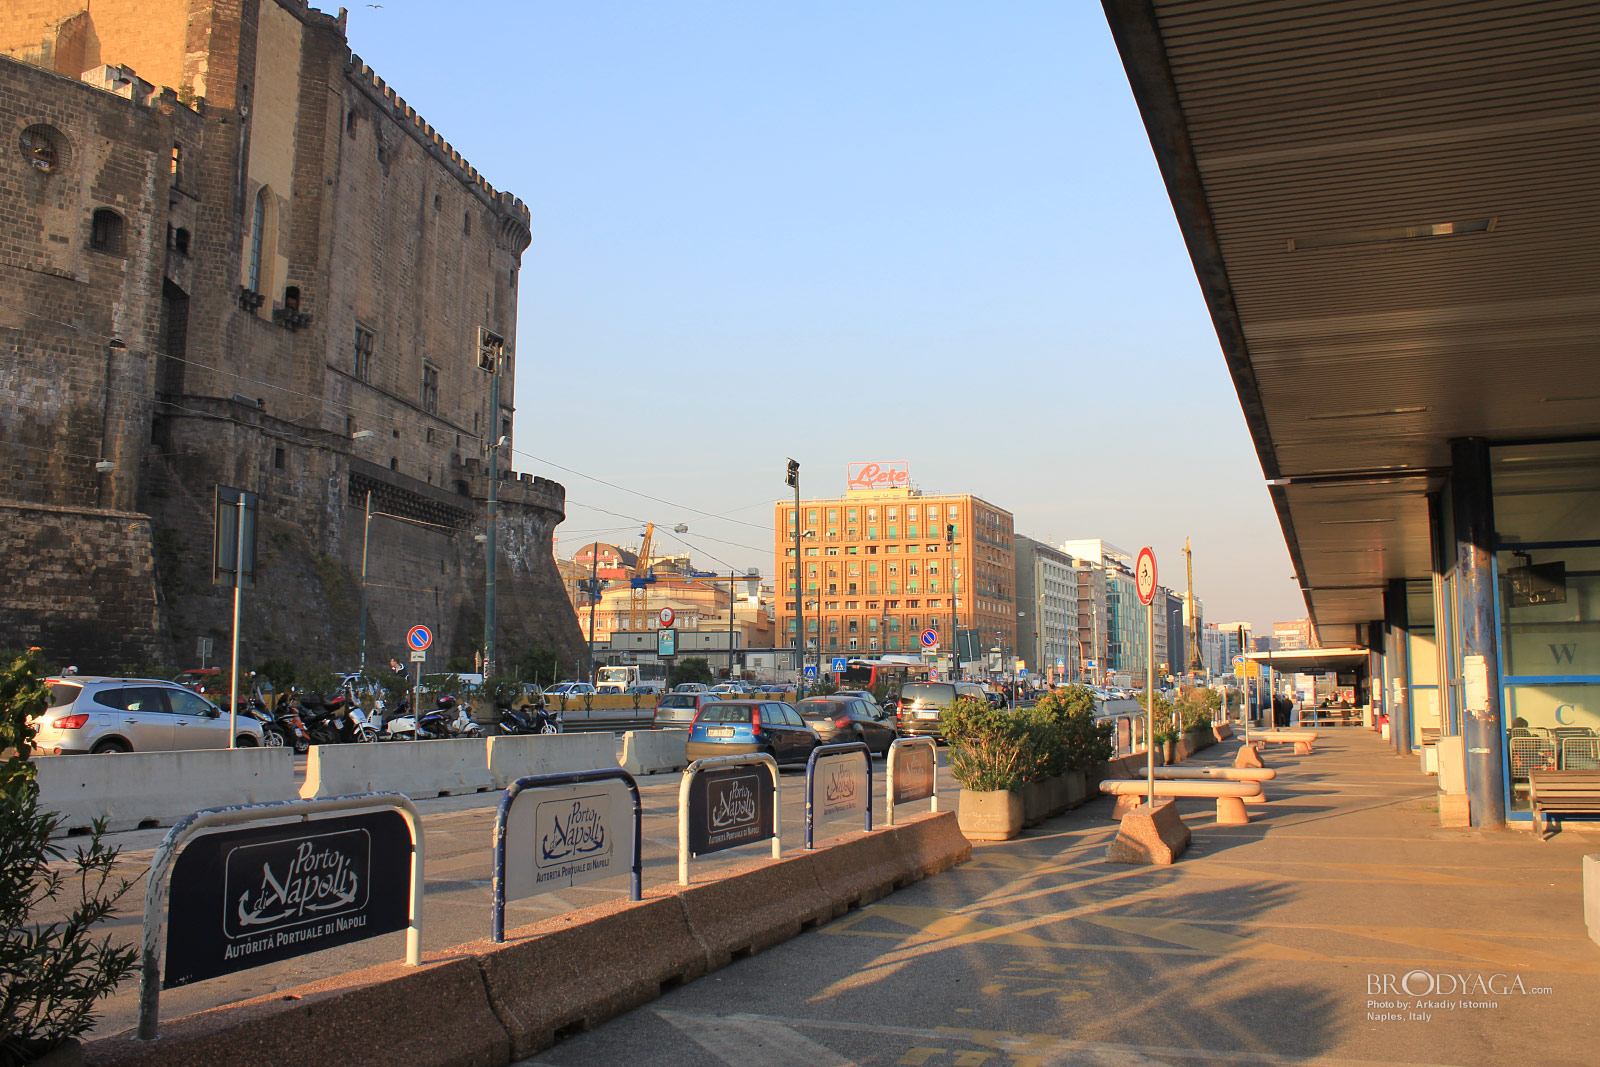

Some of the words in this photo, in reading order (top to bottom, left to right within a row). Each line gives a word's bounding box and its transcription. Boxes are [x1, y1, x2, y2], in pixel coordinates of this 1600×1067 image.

[848, 463, 907, 485] Lete
[1547, 643, 1578, 665] W
[1555, 703, 1576, 726] C
[731, 780, 750, 800] Porto
[571, 801, 595, 825] Porto
[720, 790, 753, 825] Napoli
[553, 812, 602, 856] Napoli
[297, 841, 340, 874] Porto
[253, 890, 269, 911] di
[261, 855, 352, 917] Napoli
[276, 925, 324, 947] PORTUALE
[336, 914, 367, 933] NAPOLI
